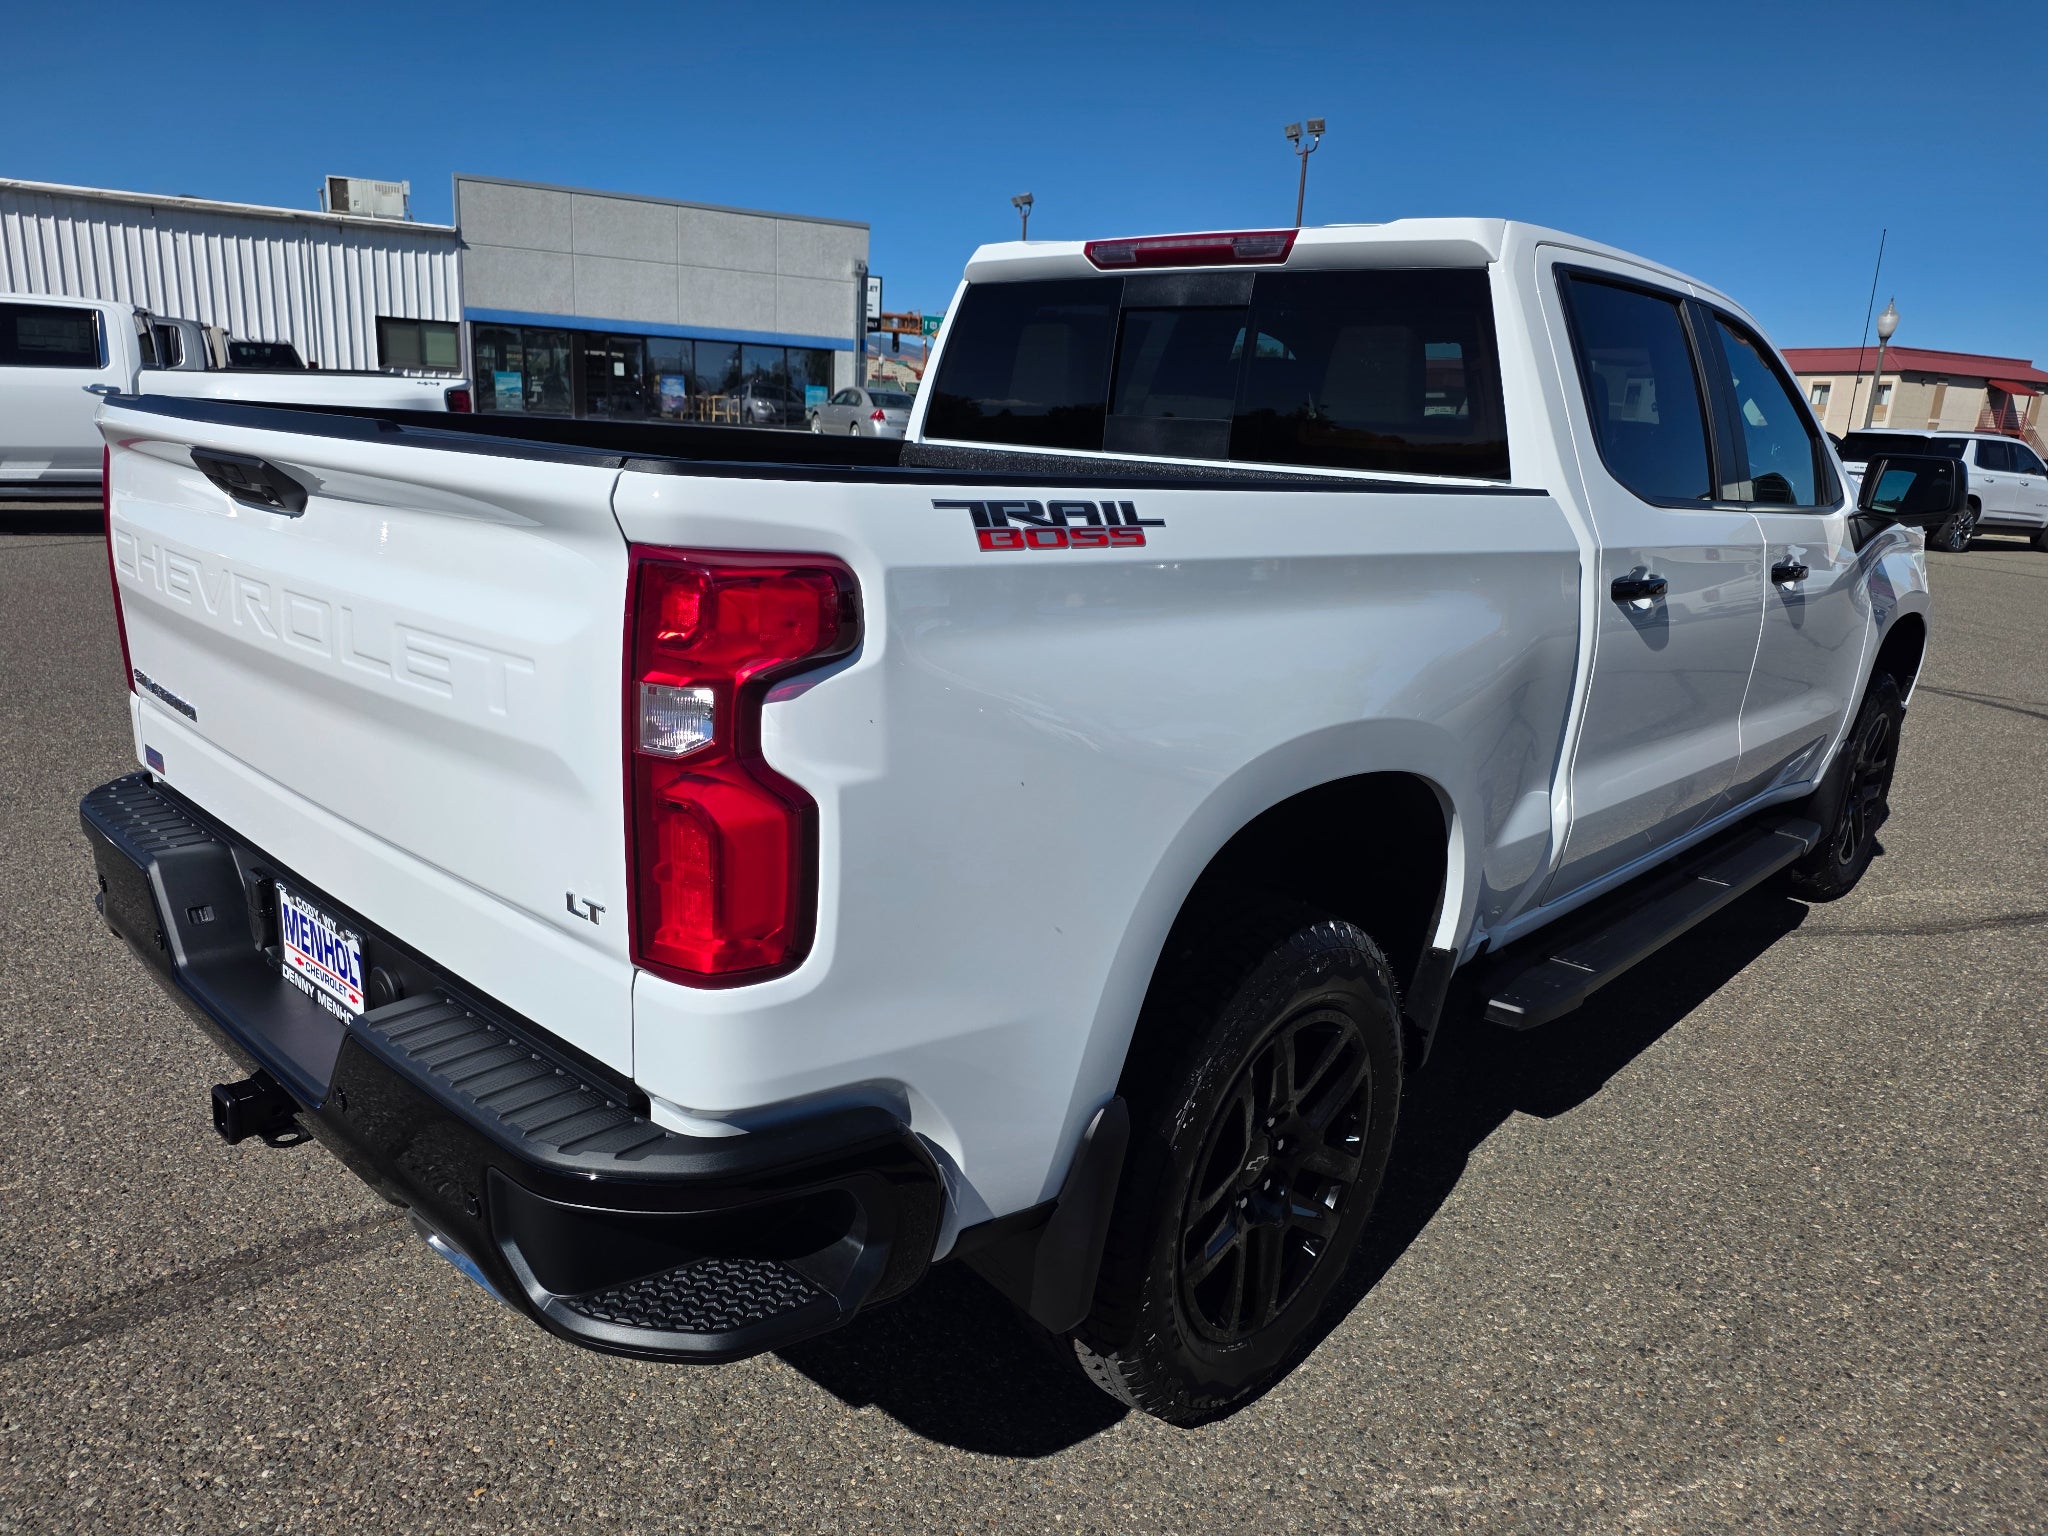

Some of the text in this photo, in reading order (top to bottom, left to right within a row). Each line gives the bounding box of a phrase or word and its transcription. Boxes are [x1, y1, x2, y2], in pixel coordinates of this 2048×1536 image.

[931, 499, 1166, 528] TRAIL
[975, 526, 1146, 552] BOSS
[114, 527, 536, 716] CHEVROLET
[322, 912, 337, 933] WY
[566, 890, 606, 926] LT
[282, 963, 315, 998] DENNY
[305, 961, 348, 998] CHEVROLET
